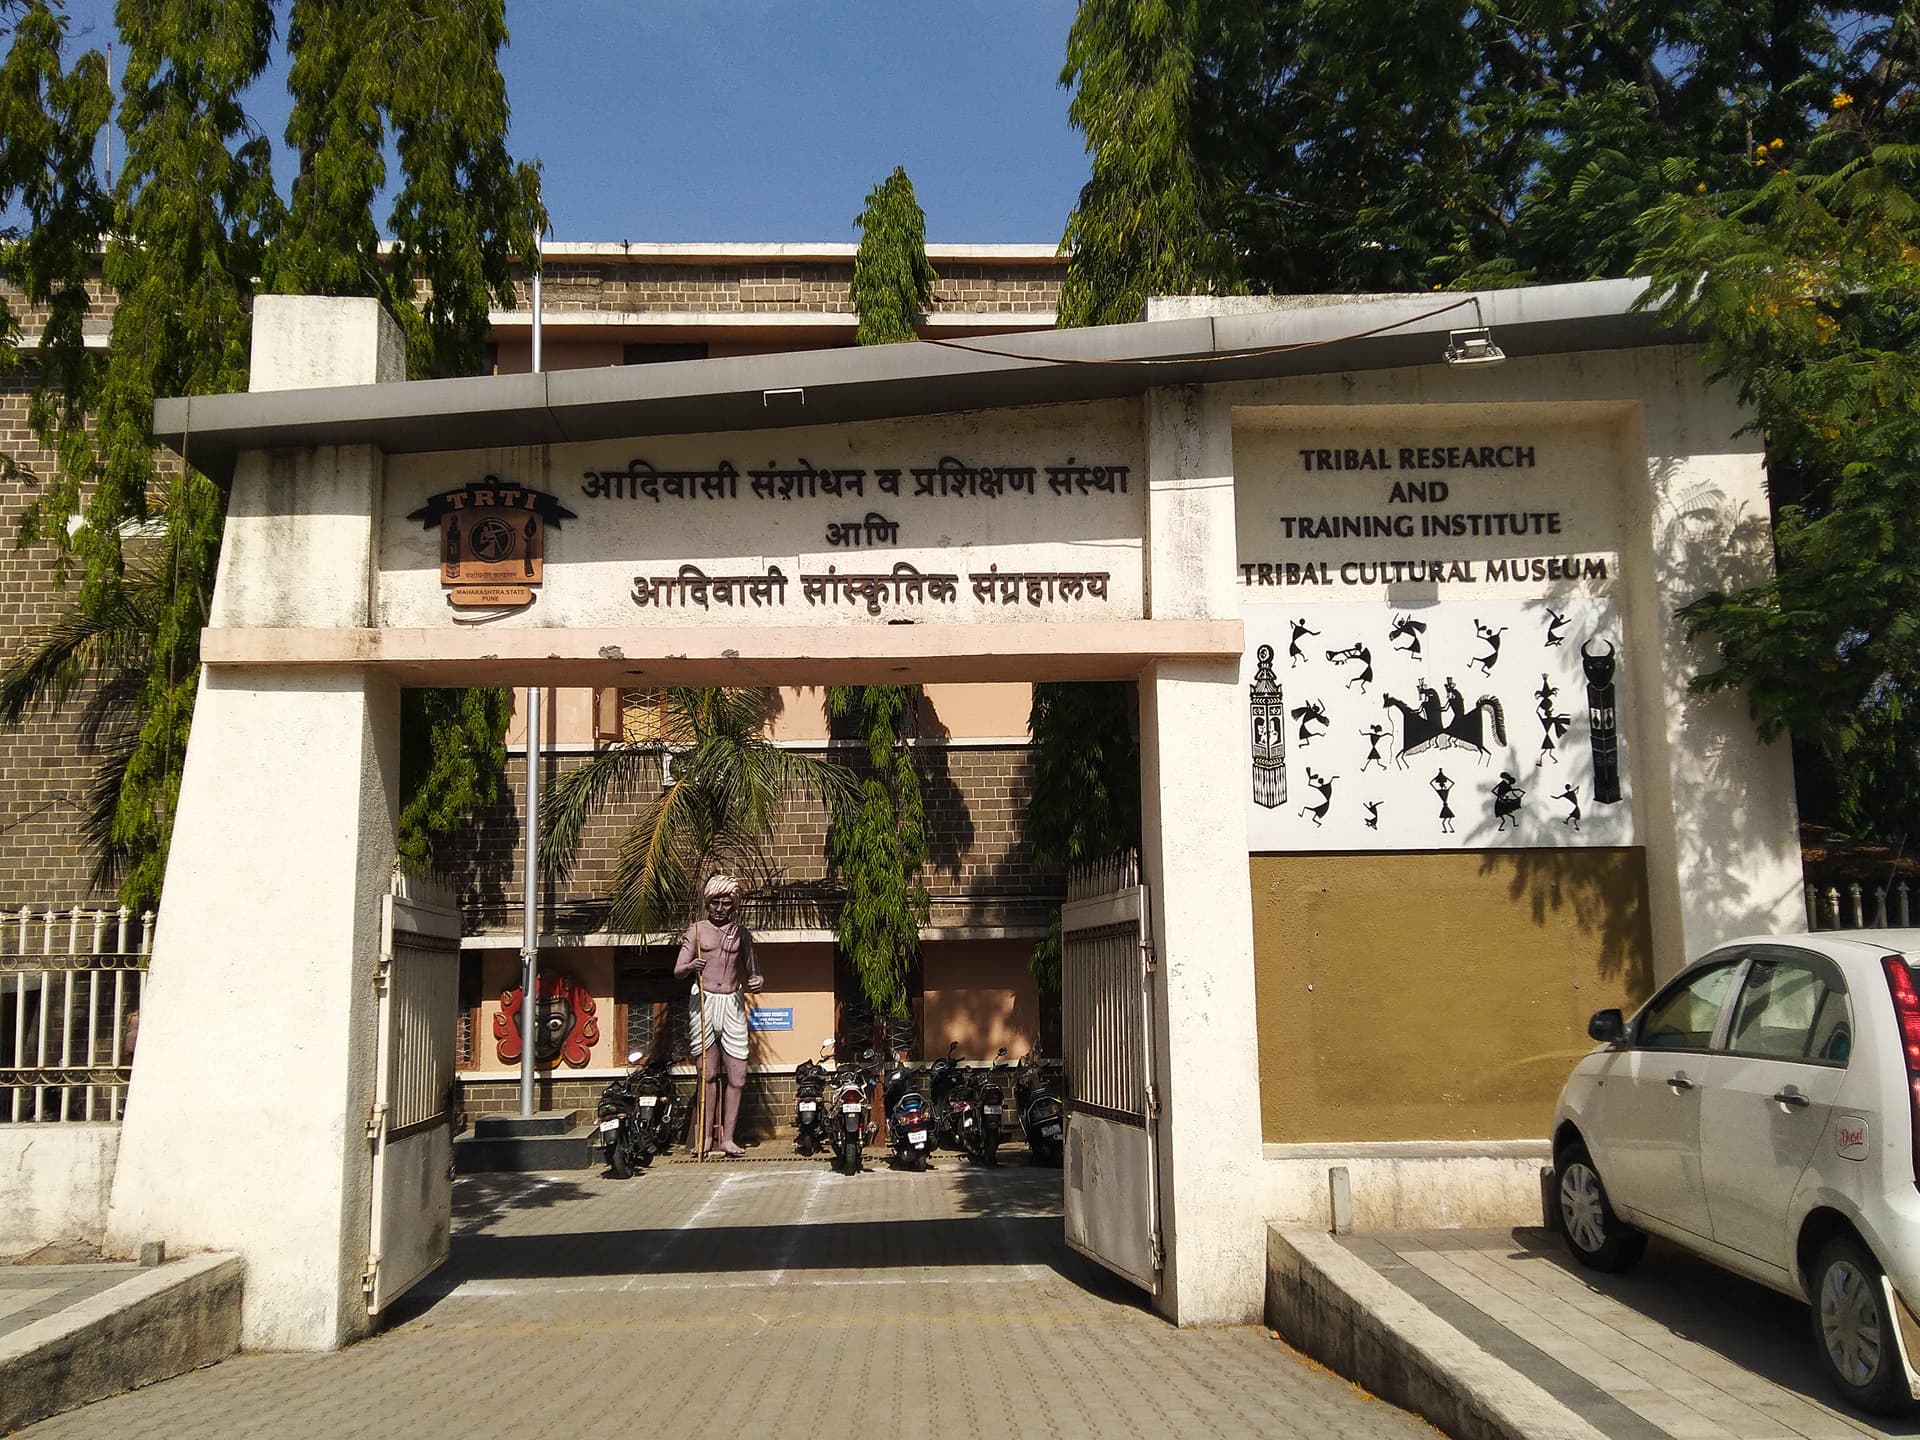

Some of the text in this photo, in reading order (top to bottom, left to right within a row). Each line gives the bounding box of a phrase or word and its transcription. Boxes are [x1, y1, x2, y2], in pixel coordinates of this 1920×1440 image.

[1300, 446, 1536, 471] TRIBAL RESEARCH
[581, 456, 1130, 502] आदिवासी संशोधन व प्रशिक्षण संस्था
[1388, 481, 1449, 504] AND
[446, 489, 537, 511] TRTI
[825, 511, 900, 546] आणि
[1280, 512, 1562, 539] TRAINING INSTITUTE
[1240, 557, 1609, 587] TRIBAL CULTURAL MUSEUM
[631, 562, 1110, 617] आदिवासी सांस्कृतिक संग्रहालय
